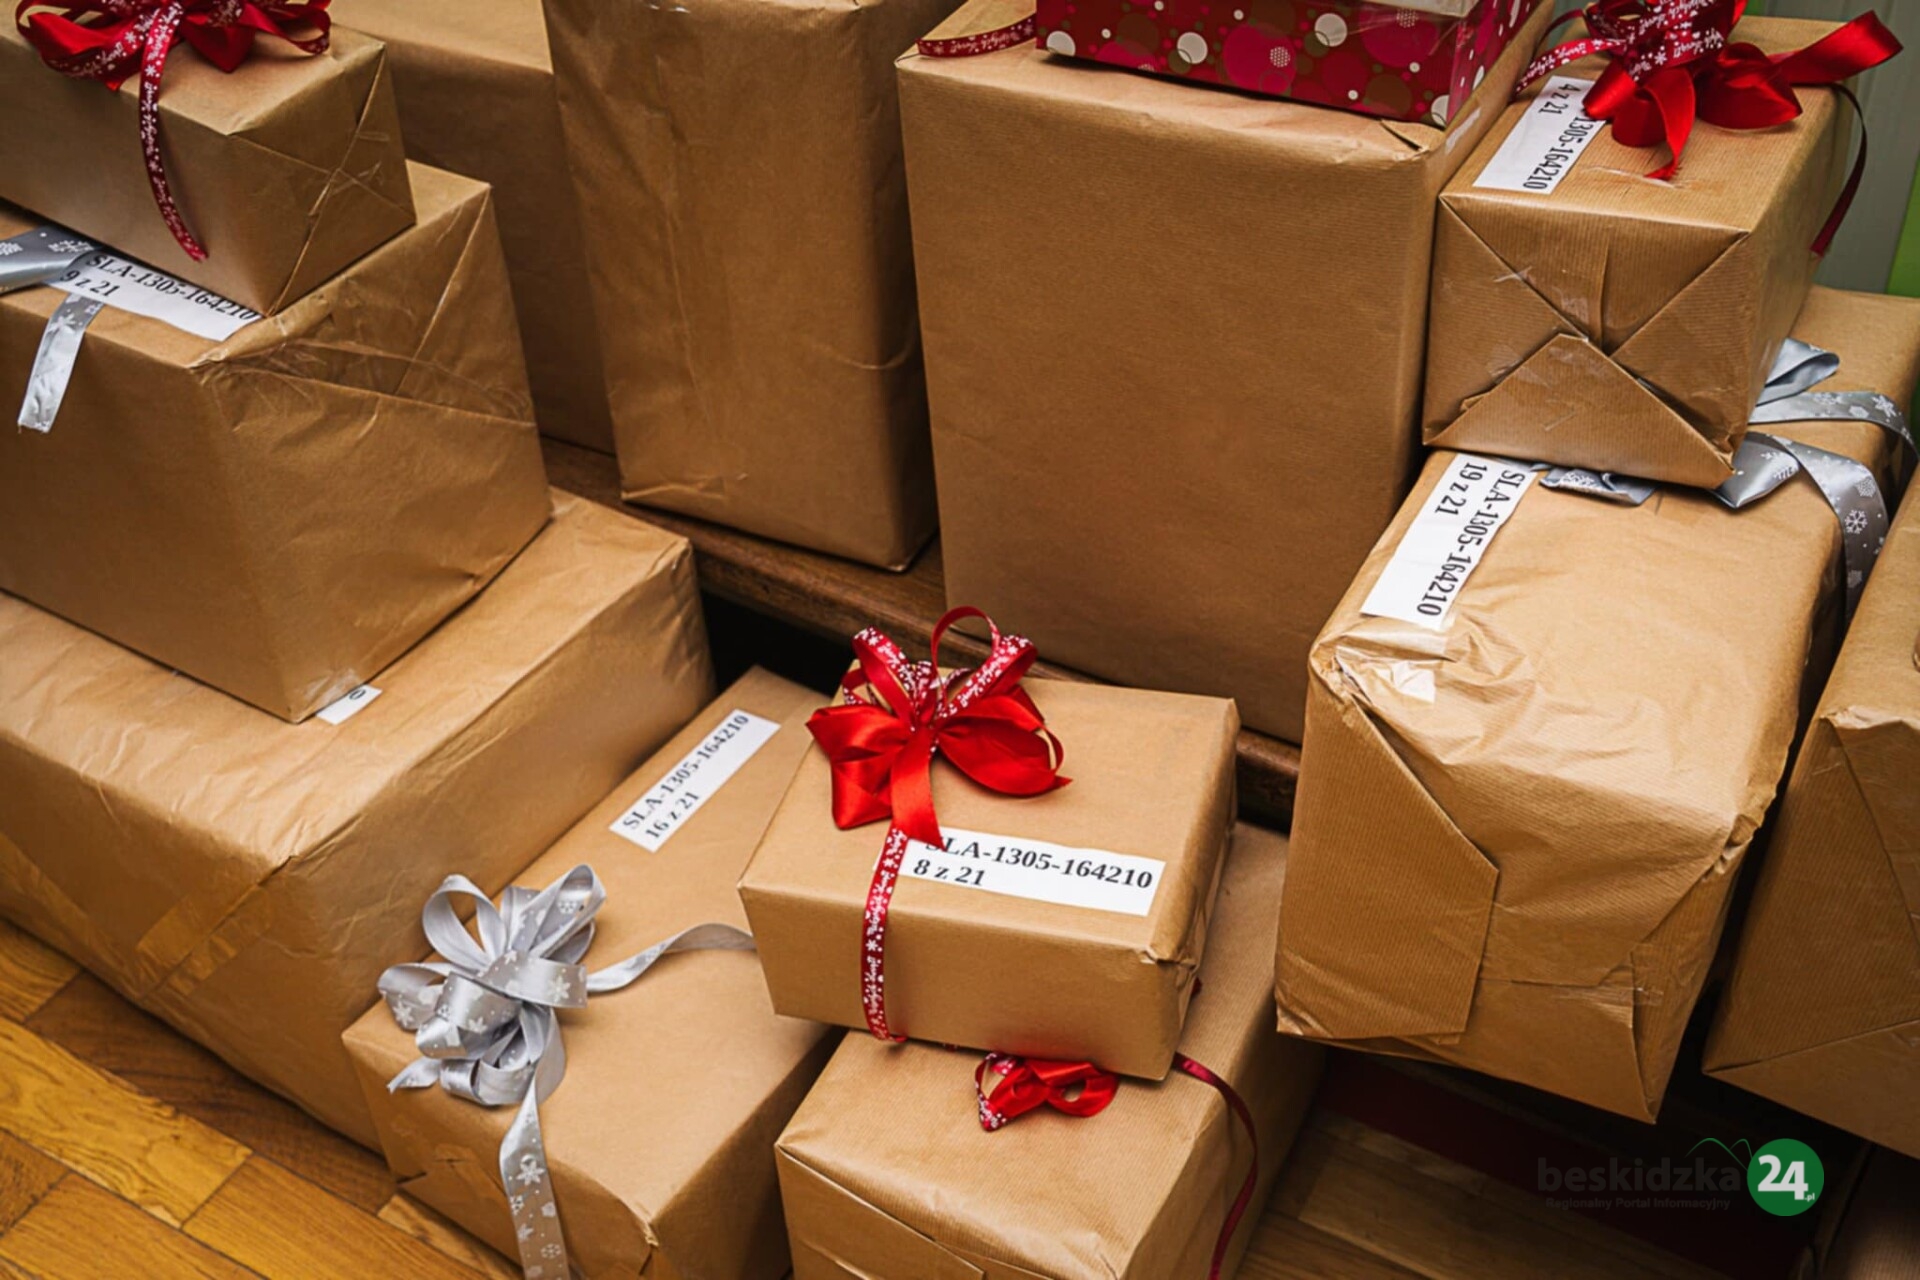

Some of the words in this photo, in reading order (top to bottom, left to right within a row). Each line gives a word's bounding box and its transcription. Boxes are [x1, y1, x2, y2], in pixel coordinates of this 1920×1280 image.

[1558, 83, 1581, 92] 4
[1538, 101, 1569, 114] 21
[1523, 106, 1597, 189] 1305-164210
[75, 277, 89, 287] z
[90, 278, 121, 297] 21
[86, 253, 258, 321] SLA-1305-164210
[1459, 462, 1488, 481] 19
[1449, 482, 1469, 492] z
[1434, 496, 1467, 516] 21
[1417, 469, 1526, 616] SLA-1305-164210
[623, 714, 749, 829] SLA-1305-164210
[645, 822, 669, 838] 16
[668, 811, 681, 820] z
[675, 791, 700, 809] 21
[913, 859, 931, 876] 8
[934, 866, 951, 880] z
[955, 866, 986, 886] 21
